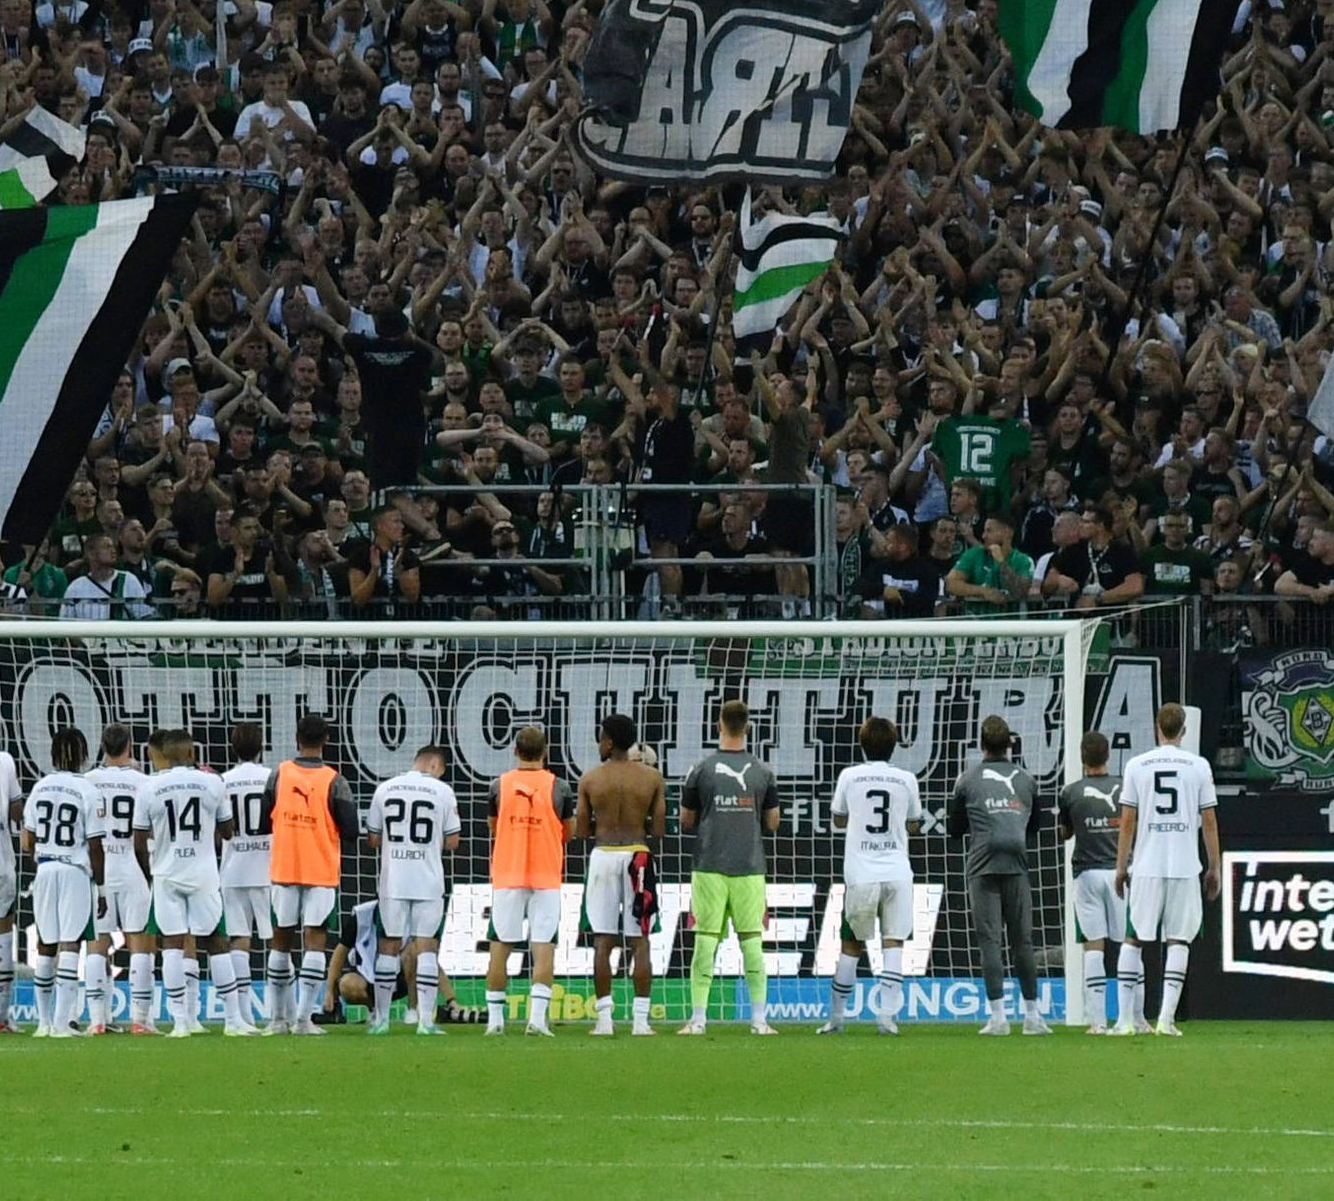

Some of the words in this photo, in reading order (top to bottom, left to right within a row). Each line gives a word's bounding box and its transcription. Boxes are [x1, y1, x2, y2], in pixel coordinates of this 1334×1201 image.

[960, 433, 994, 473] 12
[229, 792, 270, 837] 10
[865, 789, 891, 834] 3
[1153, 770, 1178, 816] 5
[35, 799, 79, 848] 38
[164, 795, 202, 842] 14
[384, 797, 436, 845] 26
